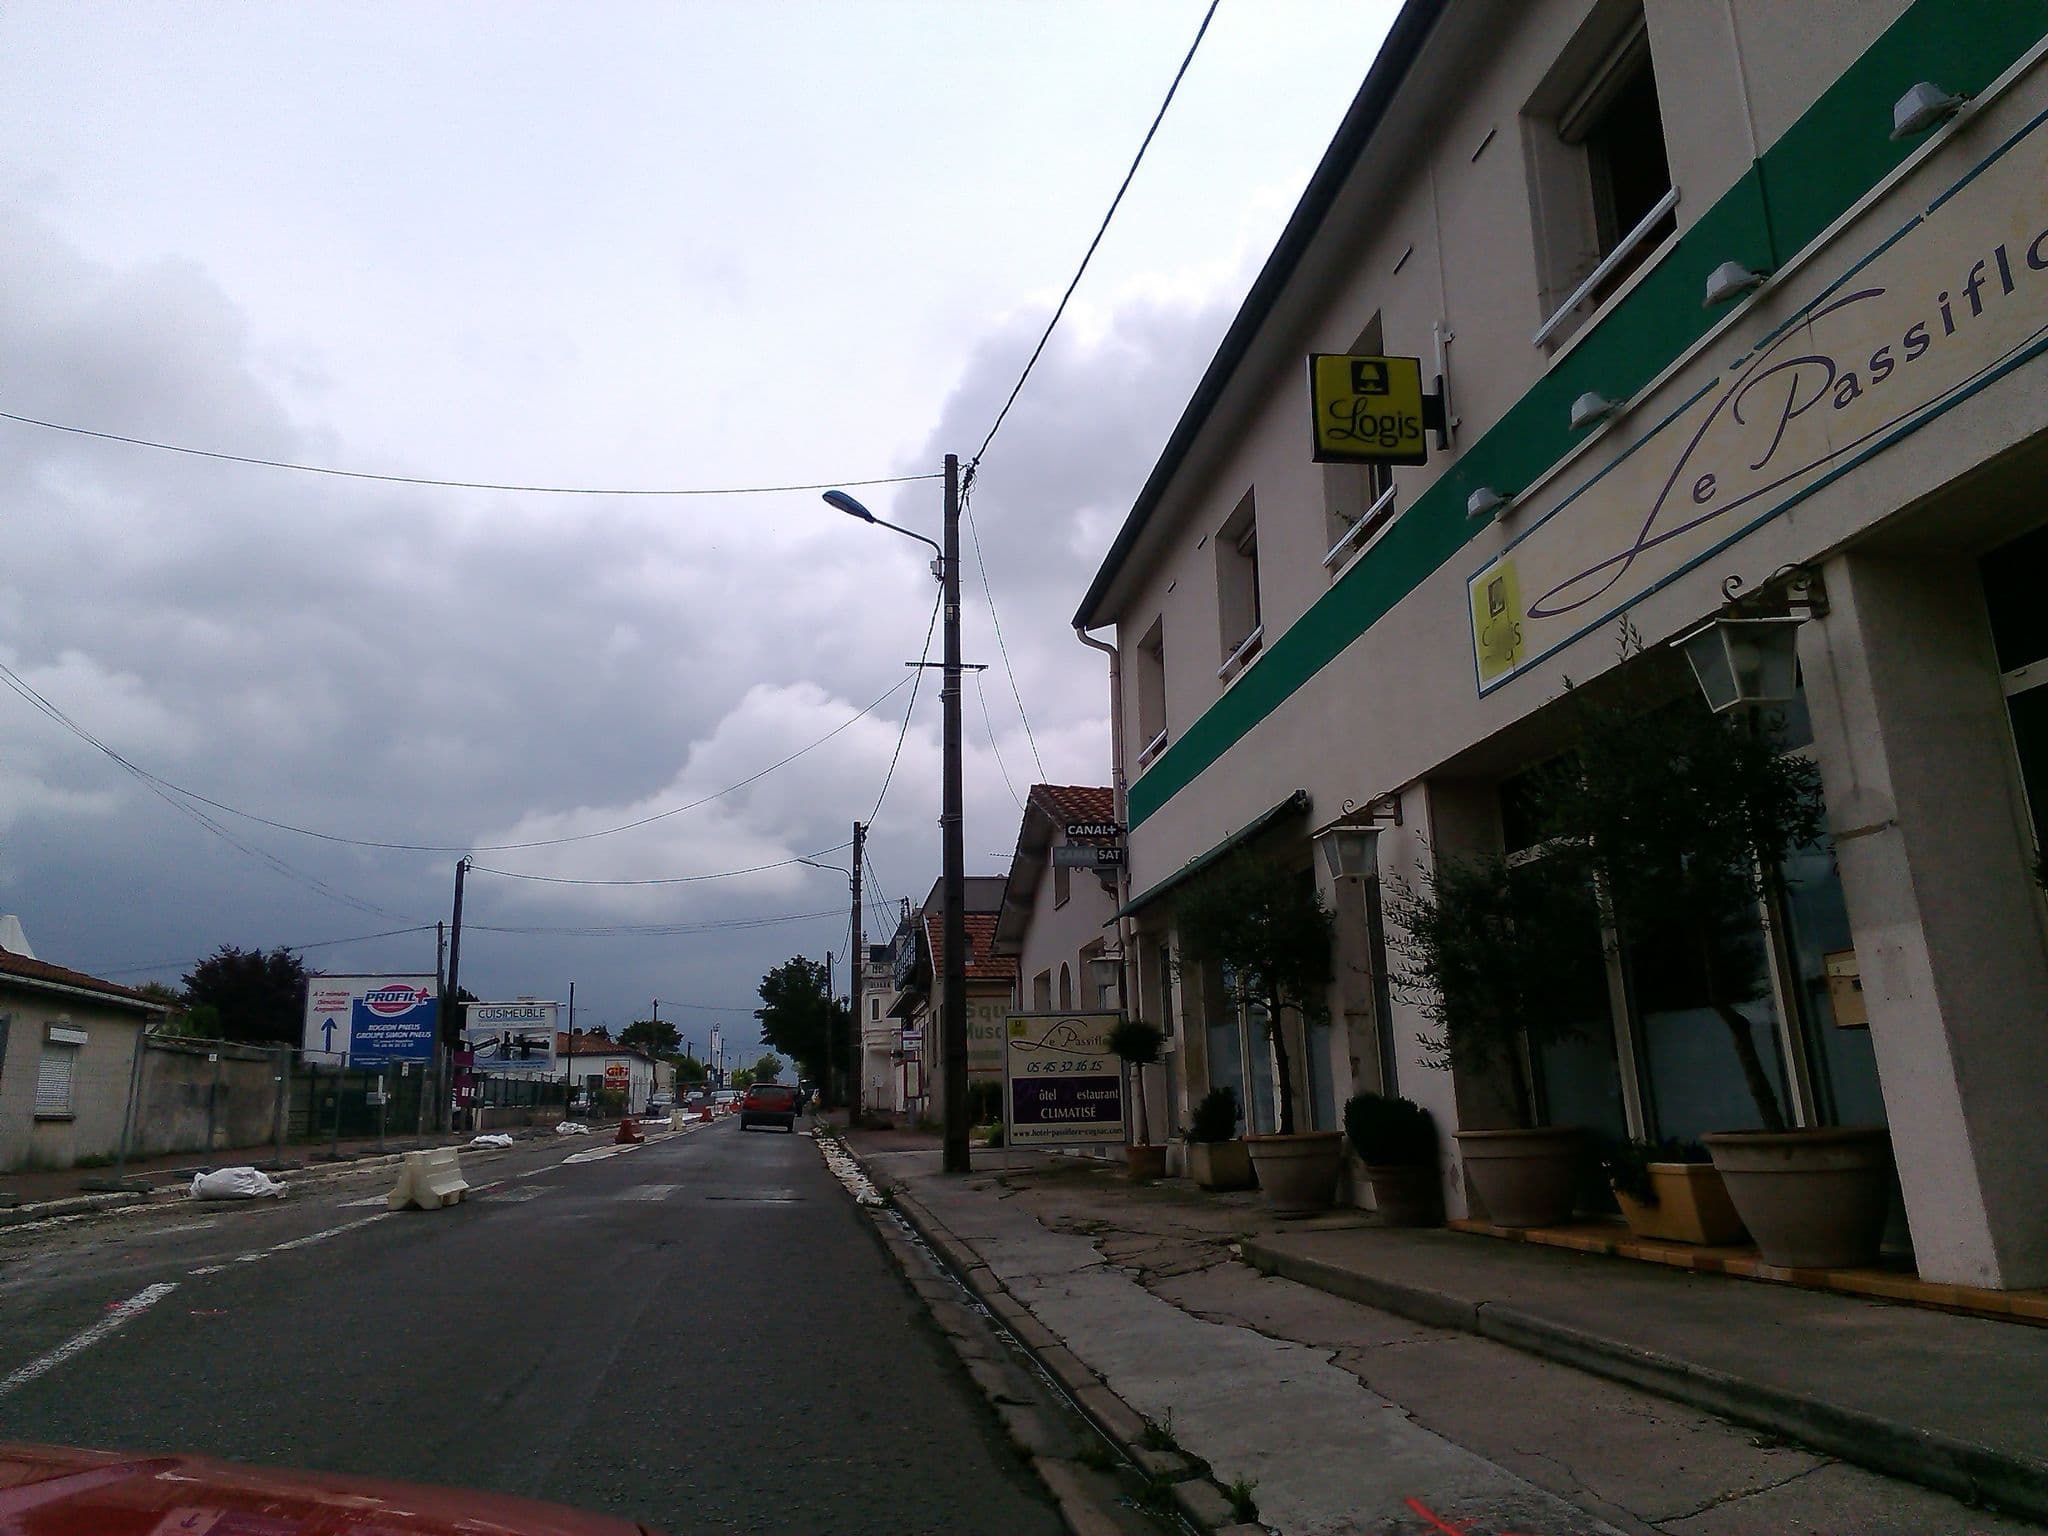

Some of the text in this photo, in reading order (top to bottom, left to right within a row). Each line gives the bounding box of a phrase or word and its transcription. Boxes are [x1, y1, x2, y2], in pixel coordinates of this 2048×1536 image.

[1326, 396, 1420, 448] Logis
[1067, 825, 1117, 835] CANAL+
[478, 1008, 546, 1019] CUISIMEUBLE
[1026, 1060, 1104, 1073] 05 45 32 16 15
[1040, 1104, 1097, 1119] CLIMATISÉ
